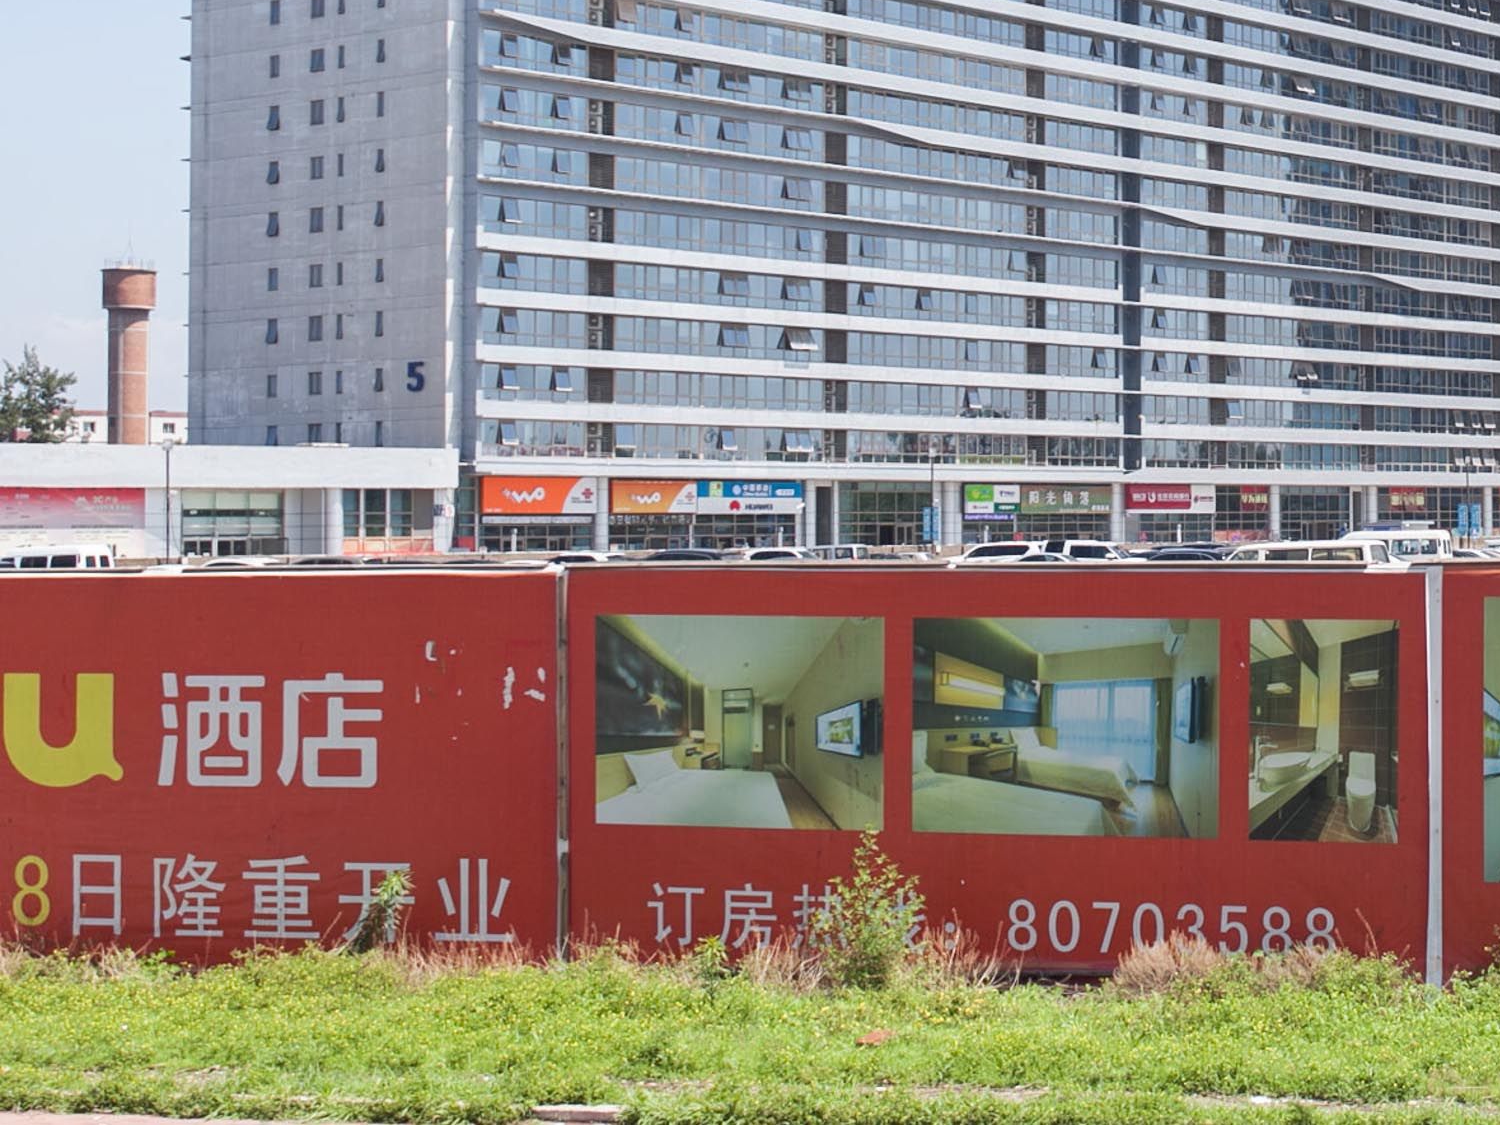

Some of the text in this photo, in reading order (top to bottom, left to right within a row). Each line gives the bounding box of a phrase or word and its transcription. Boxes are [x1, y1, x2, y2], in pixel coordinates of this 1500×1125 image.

[407, 363, 425, 392] 5
[158, 672, 384, 789] 酒店
[12, 852, 516, 943] 8日隆重开业
[1007, 898, 1339, 957] 80703588
